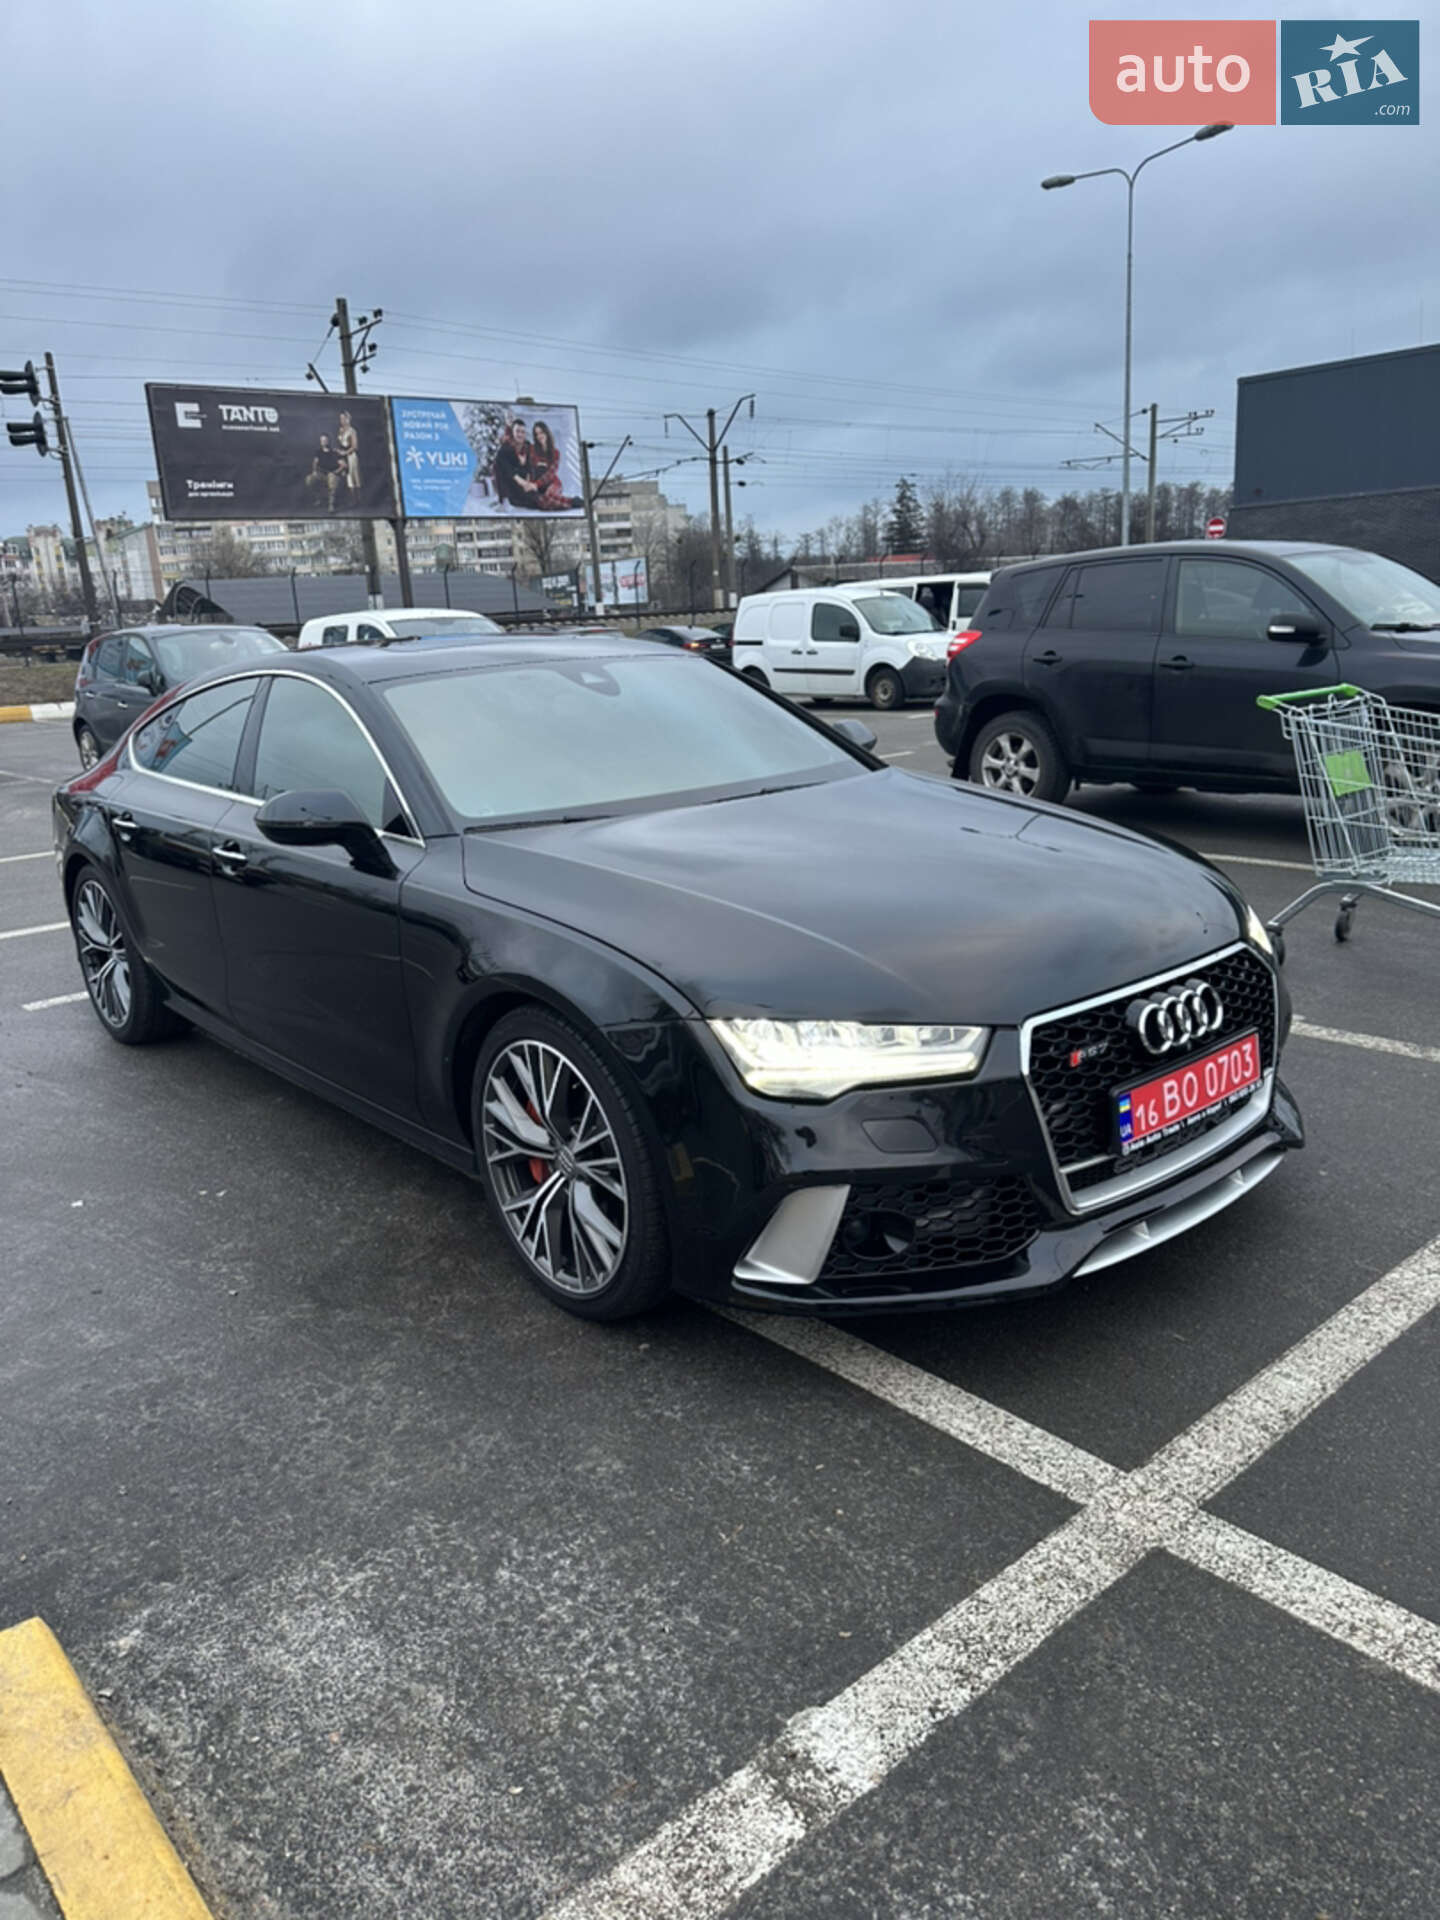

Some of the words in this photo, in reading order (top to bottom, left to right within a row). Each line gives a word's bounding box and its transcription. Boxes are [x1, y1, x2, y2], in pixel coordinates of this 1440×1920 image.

[426, 451, 468, 466] YUKI
[1136, 1098, 1159, 1131] 16
[1204, 1042, 1255, 1097] 0703
